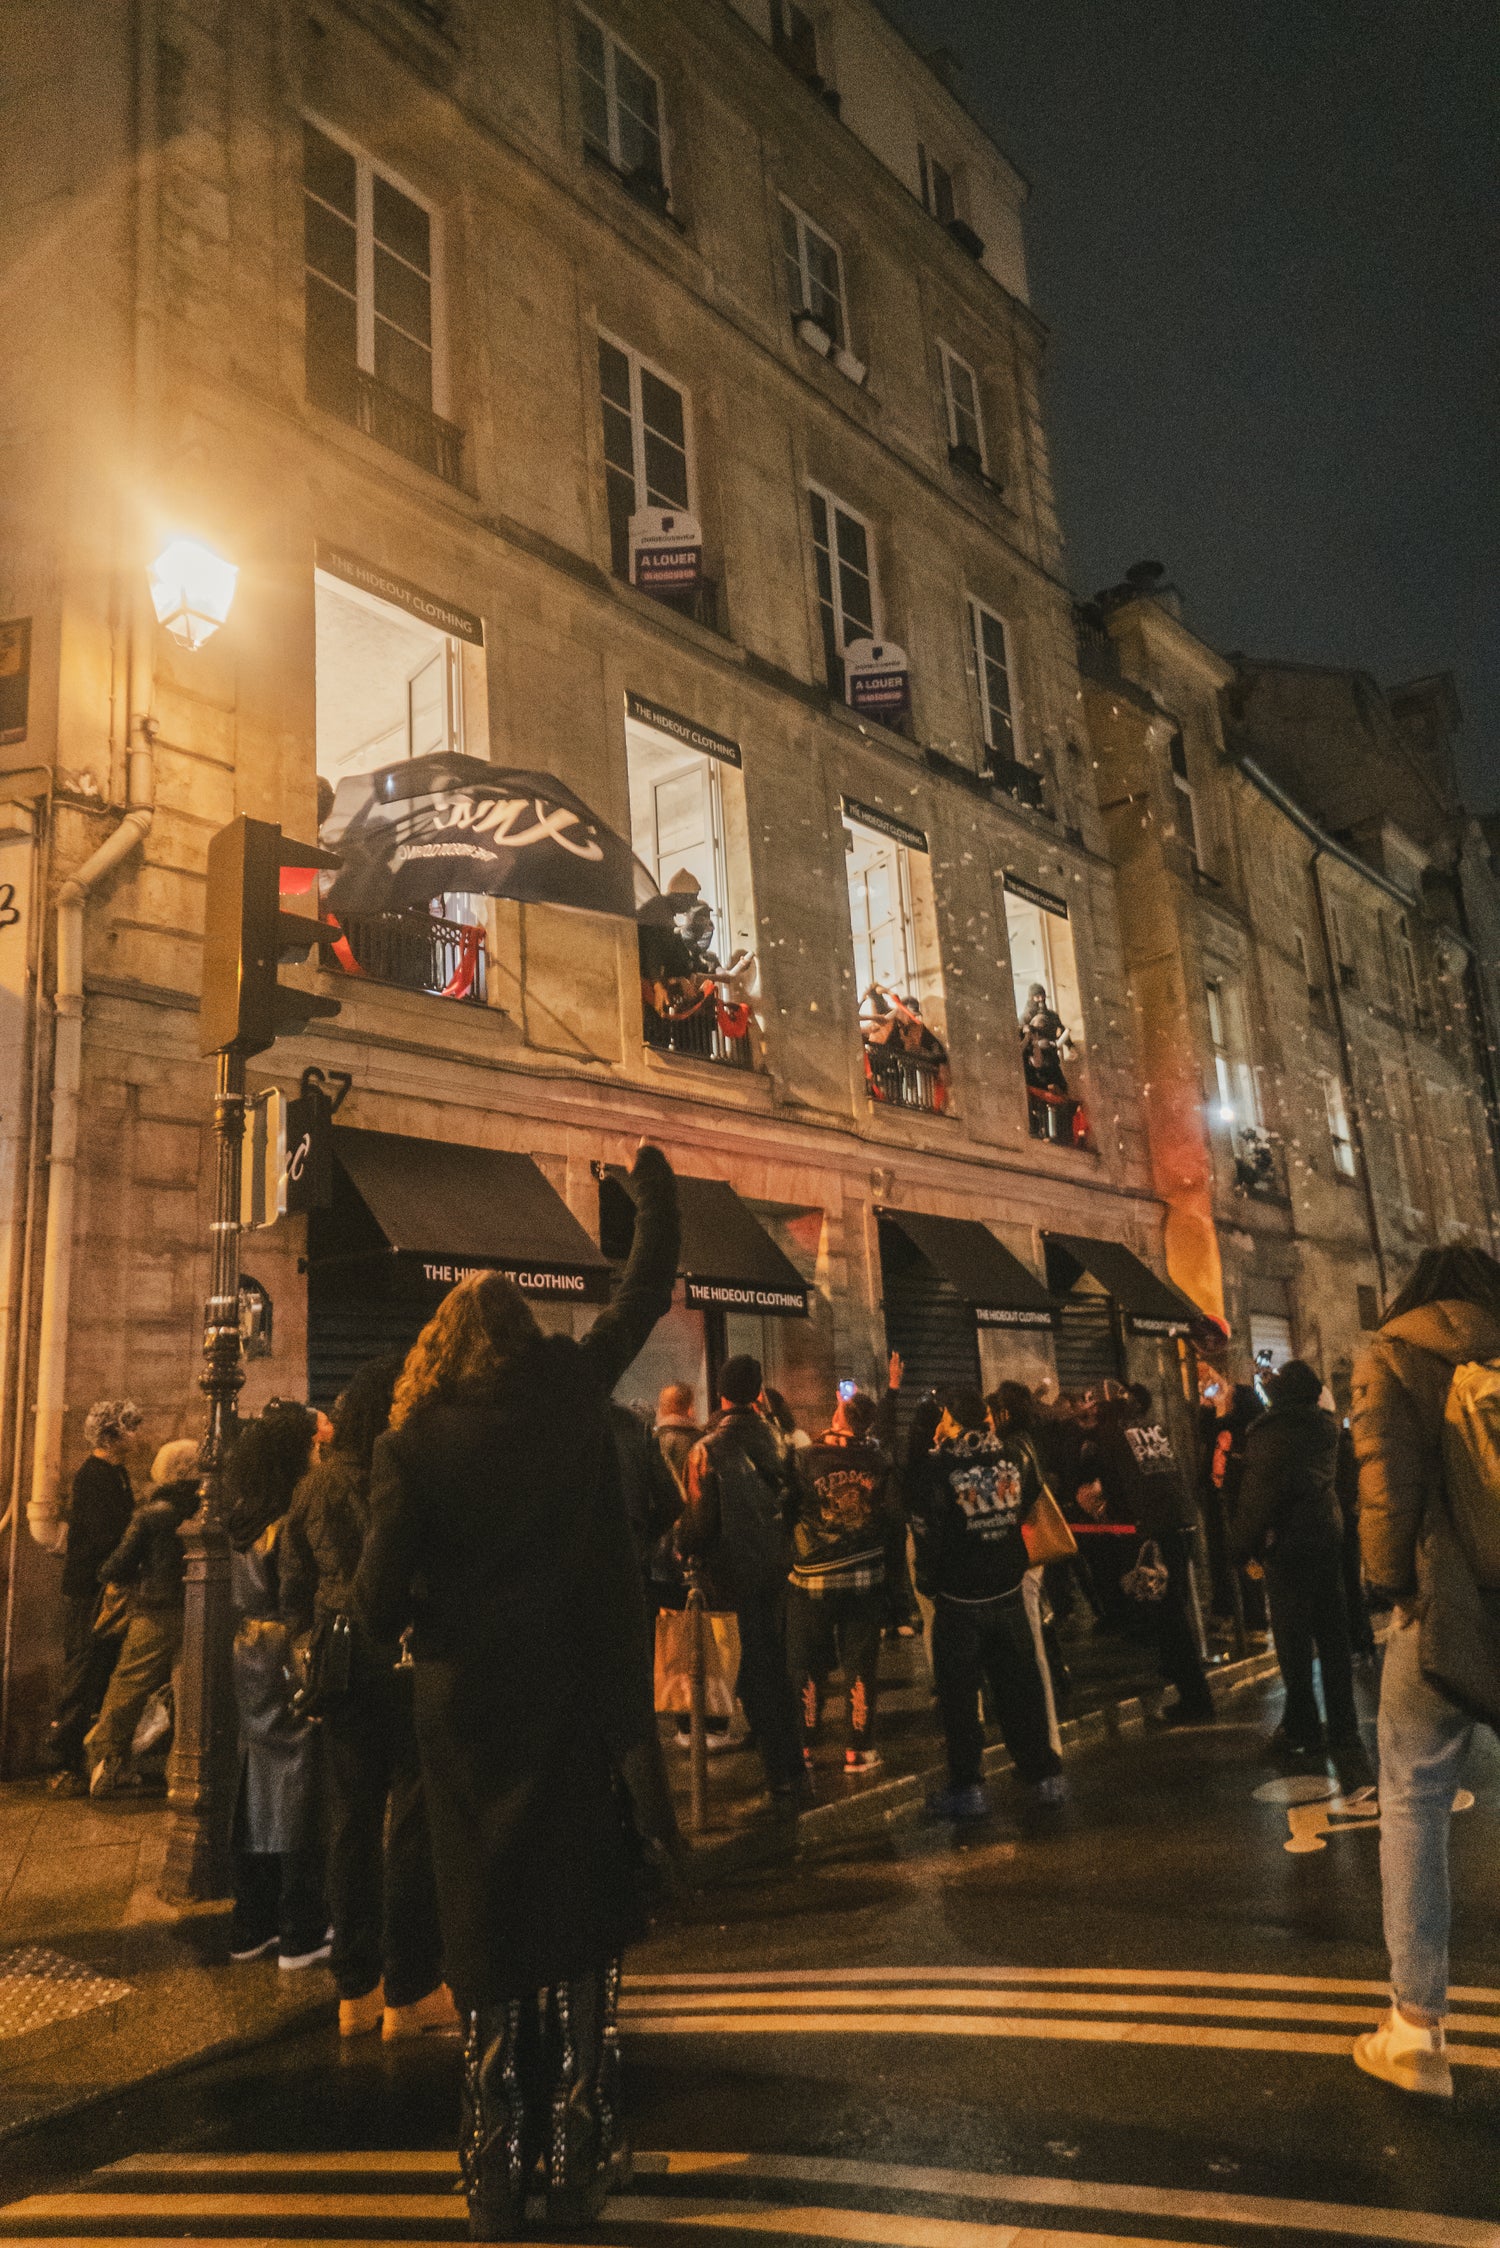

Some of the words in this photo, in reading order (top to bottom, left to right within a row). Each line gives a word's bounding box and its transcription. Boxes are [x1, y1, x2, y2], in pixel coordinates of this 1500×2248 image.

[641, 555, 650, 566] A
[653, 552, 696, 566] LOUER
[330, 552, 355, 576] THE
[356, 569, 412, 604] HIDEOUT
[412, 596, 473, 634] CLOTHING
[865, 676, 903, 689] LOUER
[634, 702, 652, 721] THE
[652, 712, 691, 740] HIDEOUT
[691, 731, 737, 759] CLOTHING
[423, 1264, 452, 1282] THE
[518, 1272, 585, 1290] CLOTHING
[689, 1284, 709, 1300] THE
[711, 1287, 755, 1304] HIDEOUT
[756, 1291, 803, 1308] CLOTHING
[1018, 1312, 1052, 1324] CLOTHING
